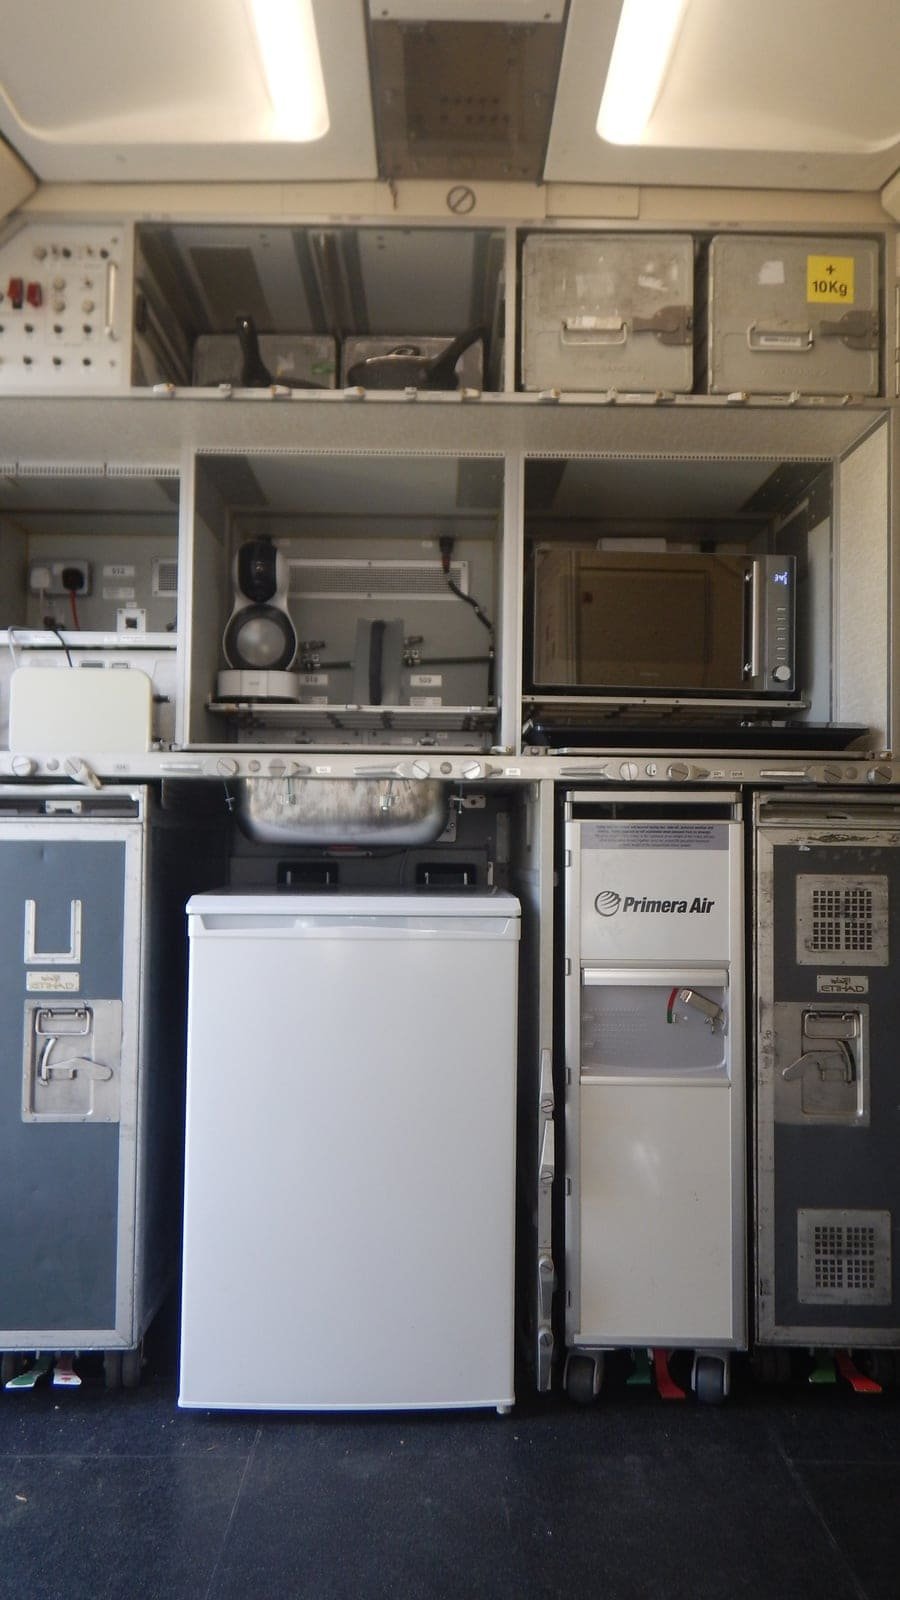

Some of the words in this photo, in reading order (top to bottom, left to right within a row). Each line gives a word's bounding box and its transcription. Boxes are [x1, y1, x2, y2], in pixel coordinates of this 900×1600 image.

[813, 280, 847, 297] 10Kg
[623, 896, 687, 914] Primera
[689, 897, 715, 914] Air
[821, 984, 865, 993] ETIHAD
